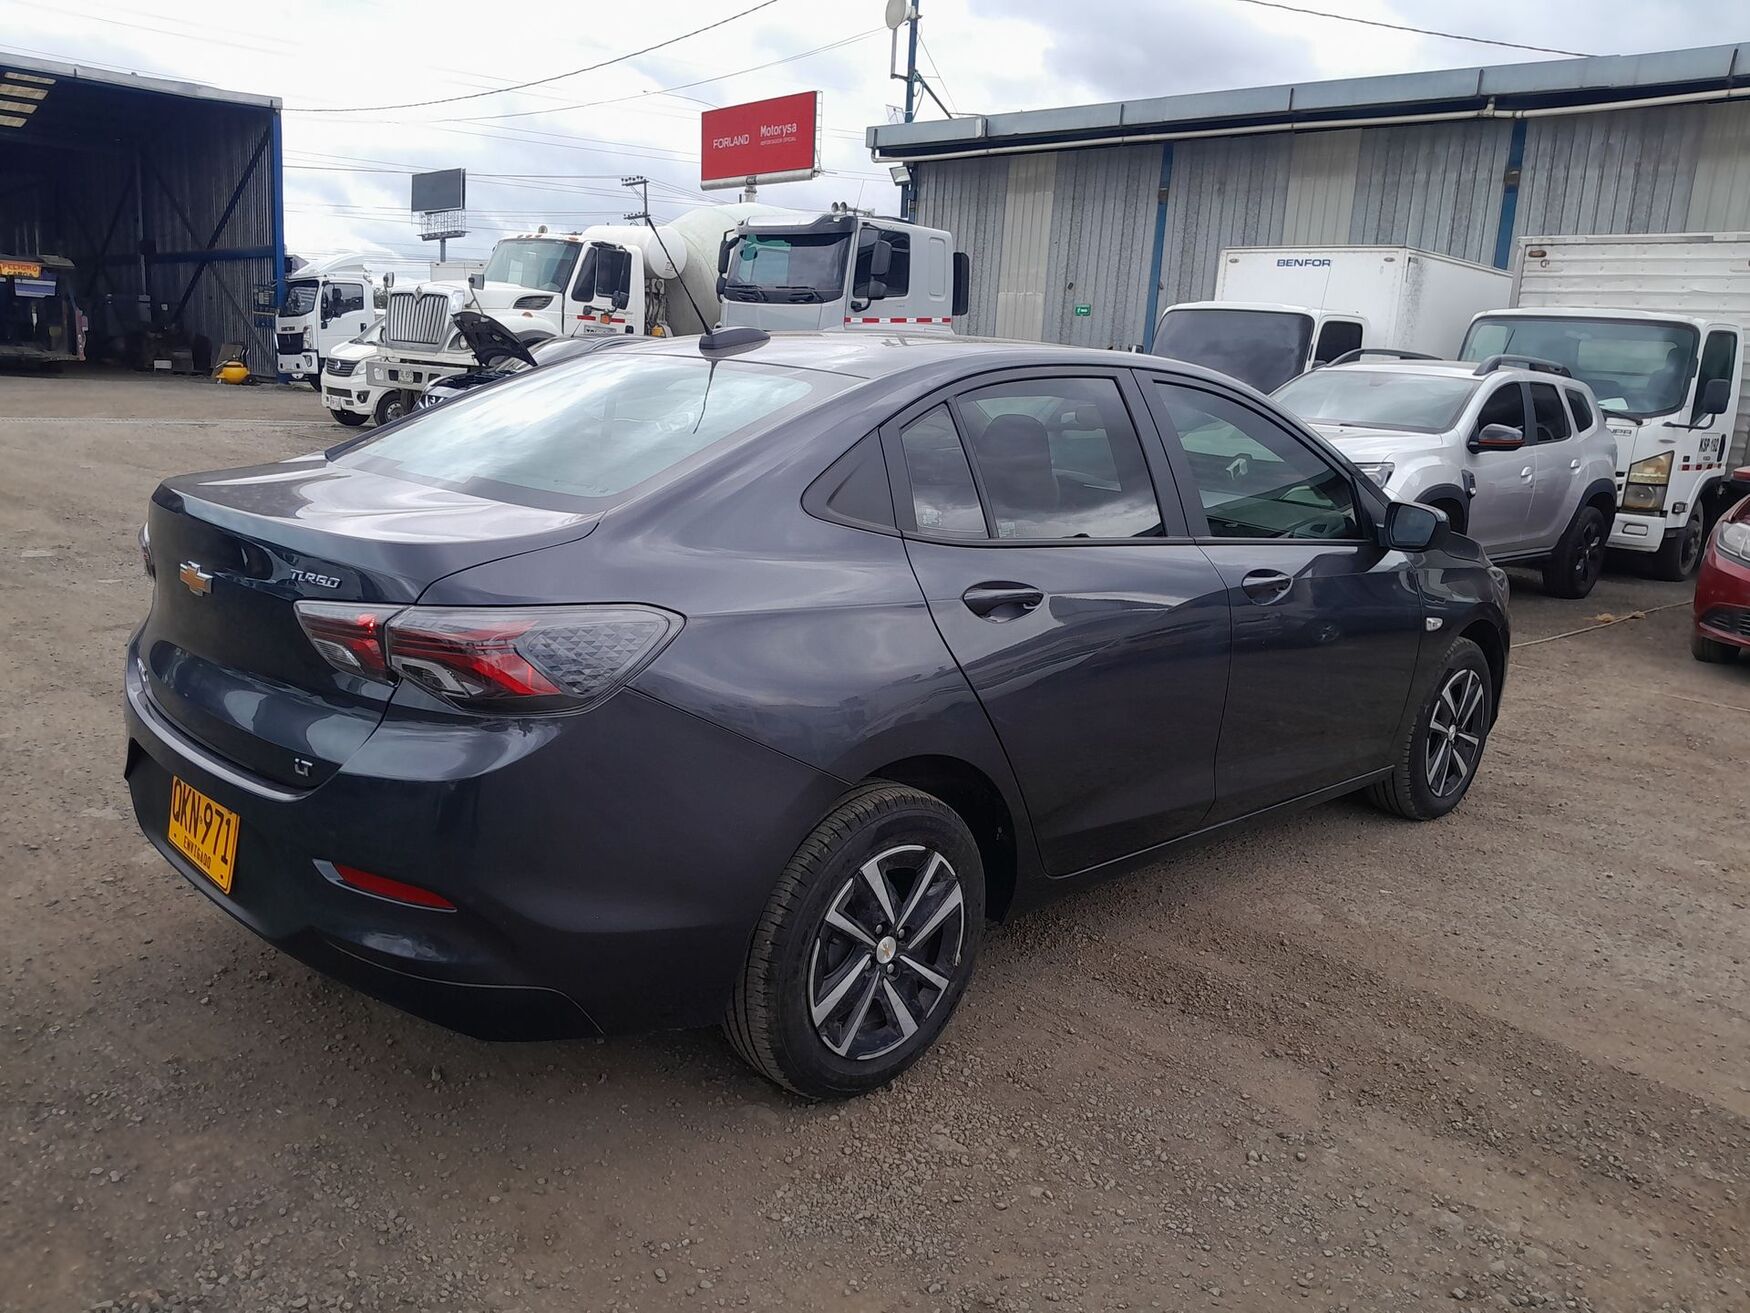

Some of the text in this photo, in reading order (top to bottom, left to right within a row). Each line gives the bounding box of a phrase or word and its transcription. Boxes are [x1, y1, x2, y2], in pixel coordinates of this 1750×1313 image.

[760, 123, 797, 137] Motorysa
[713, 134, 750, 149] FORLAND
[1277, 259, 1331, 267] BENFOR
[290, 569, 340, 588] TURBO
[295, 758, 312, 776] LT
[183, 835, 212, 870] ENVIGADO
